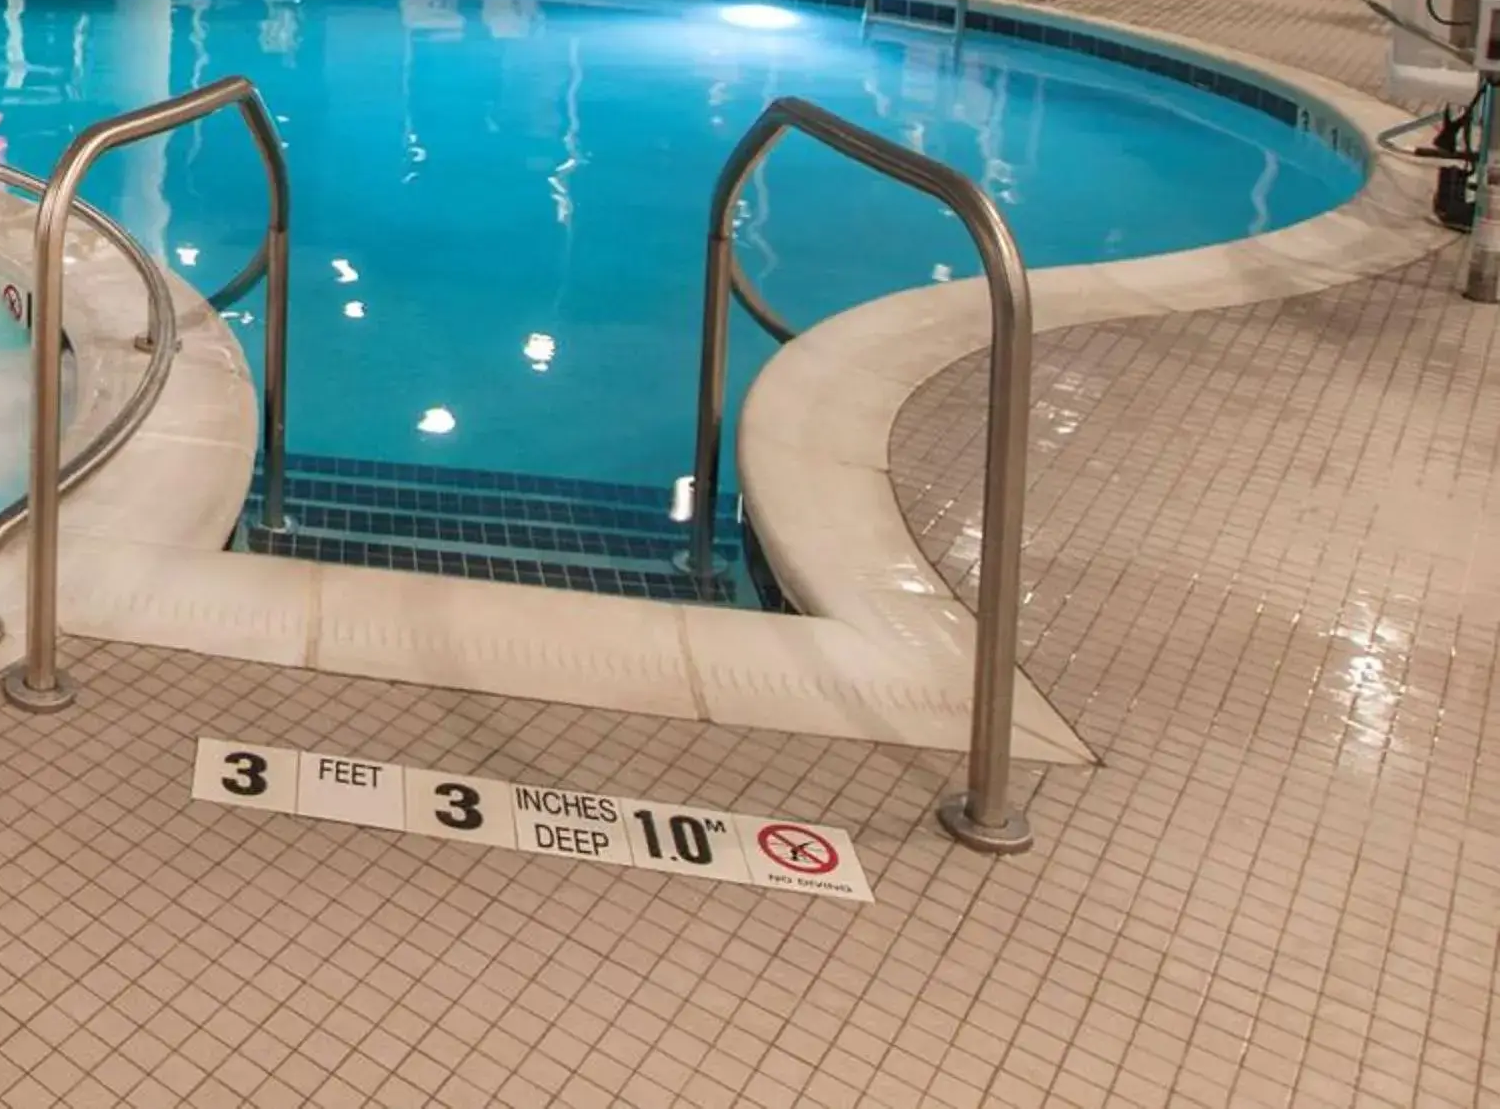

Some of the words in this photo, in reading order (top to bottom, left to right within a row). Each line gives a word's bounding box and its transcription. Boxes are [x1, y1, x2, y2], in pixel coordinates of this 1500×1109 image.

[222, 751, 267, 796] 3
[319, 758, 383, 789] FEET
[435, 782, 484, 831] 3
[515, 787, 618, 824] INCHES
[534, 823, 609, 856] DEEP
